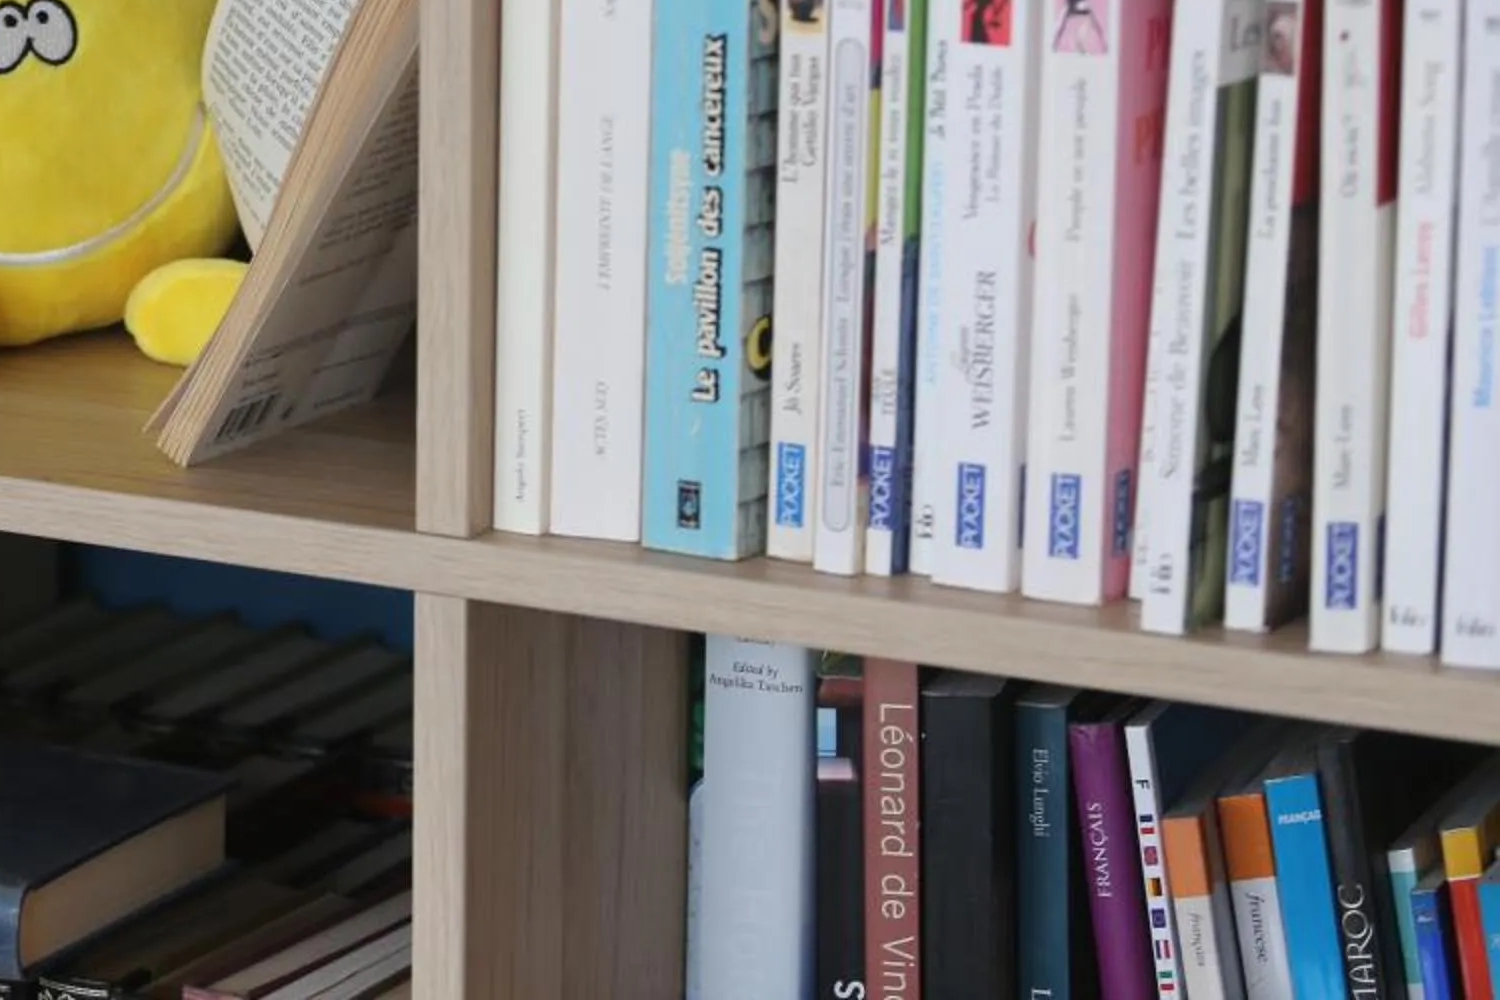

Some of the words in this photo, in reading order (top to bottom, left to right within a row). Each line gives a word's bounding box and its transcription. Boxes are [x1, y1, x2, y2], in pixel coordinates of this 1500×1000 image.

[701, 31, 728, 177] cancéreux
[696, 183, 724, 237] des
[692, 246, 727, 361] pavillon
[690, 365, 721, 405] Le
[970, 269, 997, 431] WEISBERGER
[781, 446, 801, 527] POCKET
[871, 448, 893, 530] POCKET
[959, 466, 981, 546] POCKET
[1052, 477, 1077, 559] POCKET
[732, 660, 764, 675] Edited
[766, 664, 780, 680] by
[879, 701, 916, 859] Léonard
[1032, 747, 1053, 786] Elvio
[1029, 788, 1053, 839] Lunghi
[1085, 800, 1114, 900] FRANÇAIS
[881, 870, 917, 921] de
